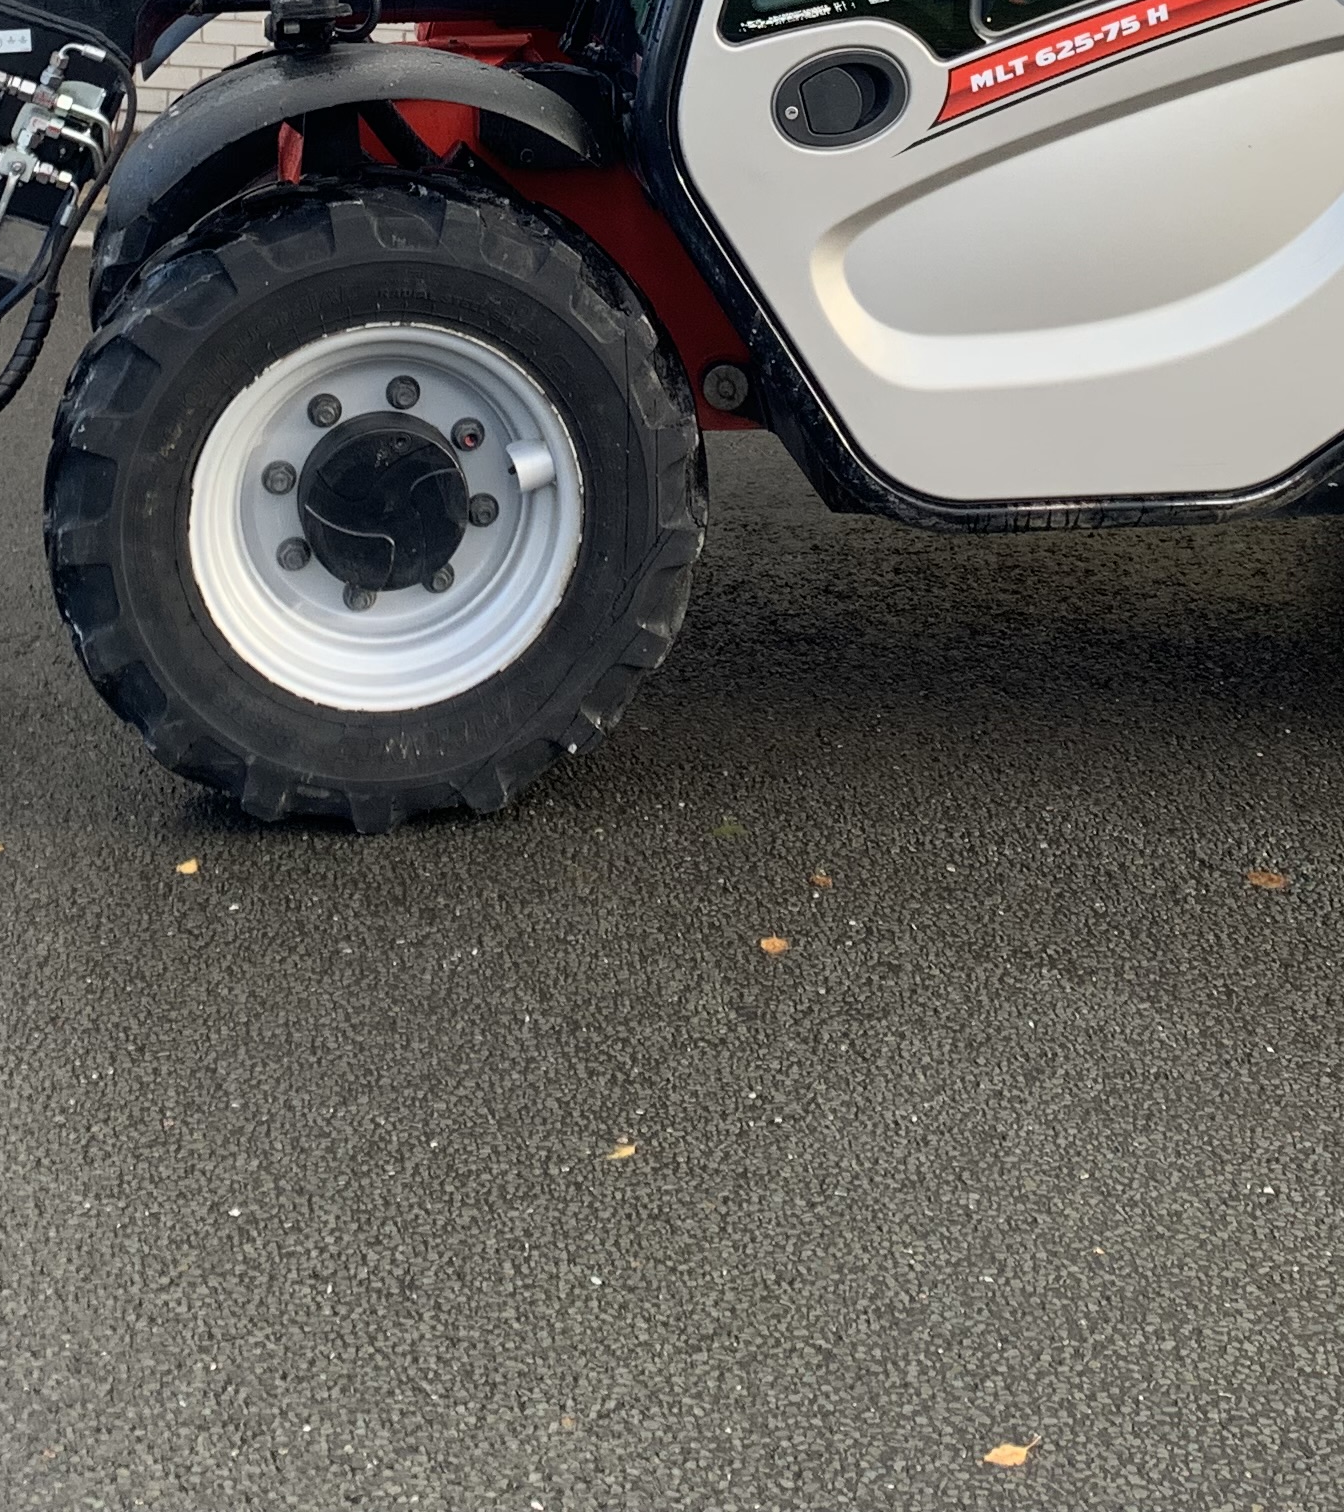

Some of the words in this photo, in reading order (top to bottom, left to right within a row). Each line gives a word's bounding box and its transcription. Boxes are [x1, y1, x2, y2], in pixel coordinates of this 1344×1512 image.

[970, 55, 1029, 93] MLT
[1035, 15, 1141, 68] 625-75
[1146, 3, 1169, 27] H
